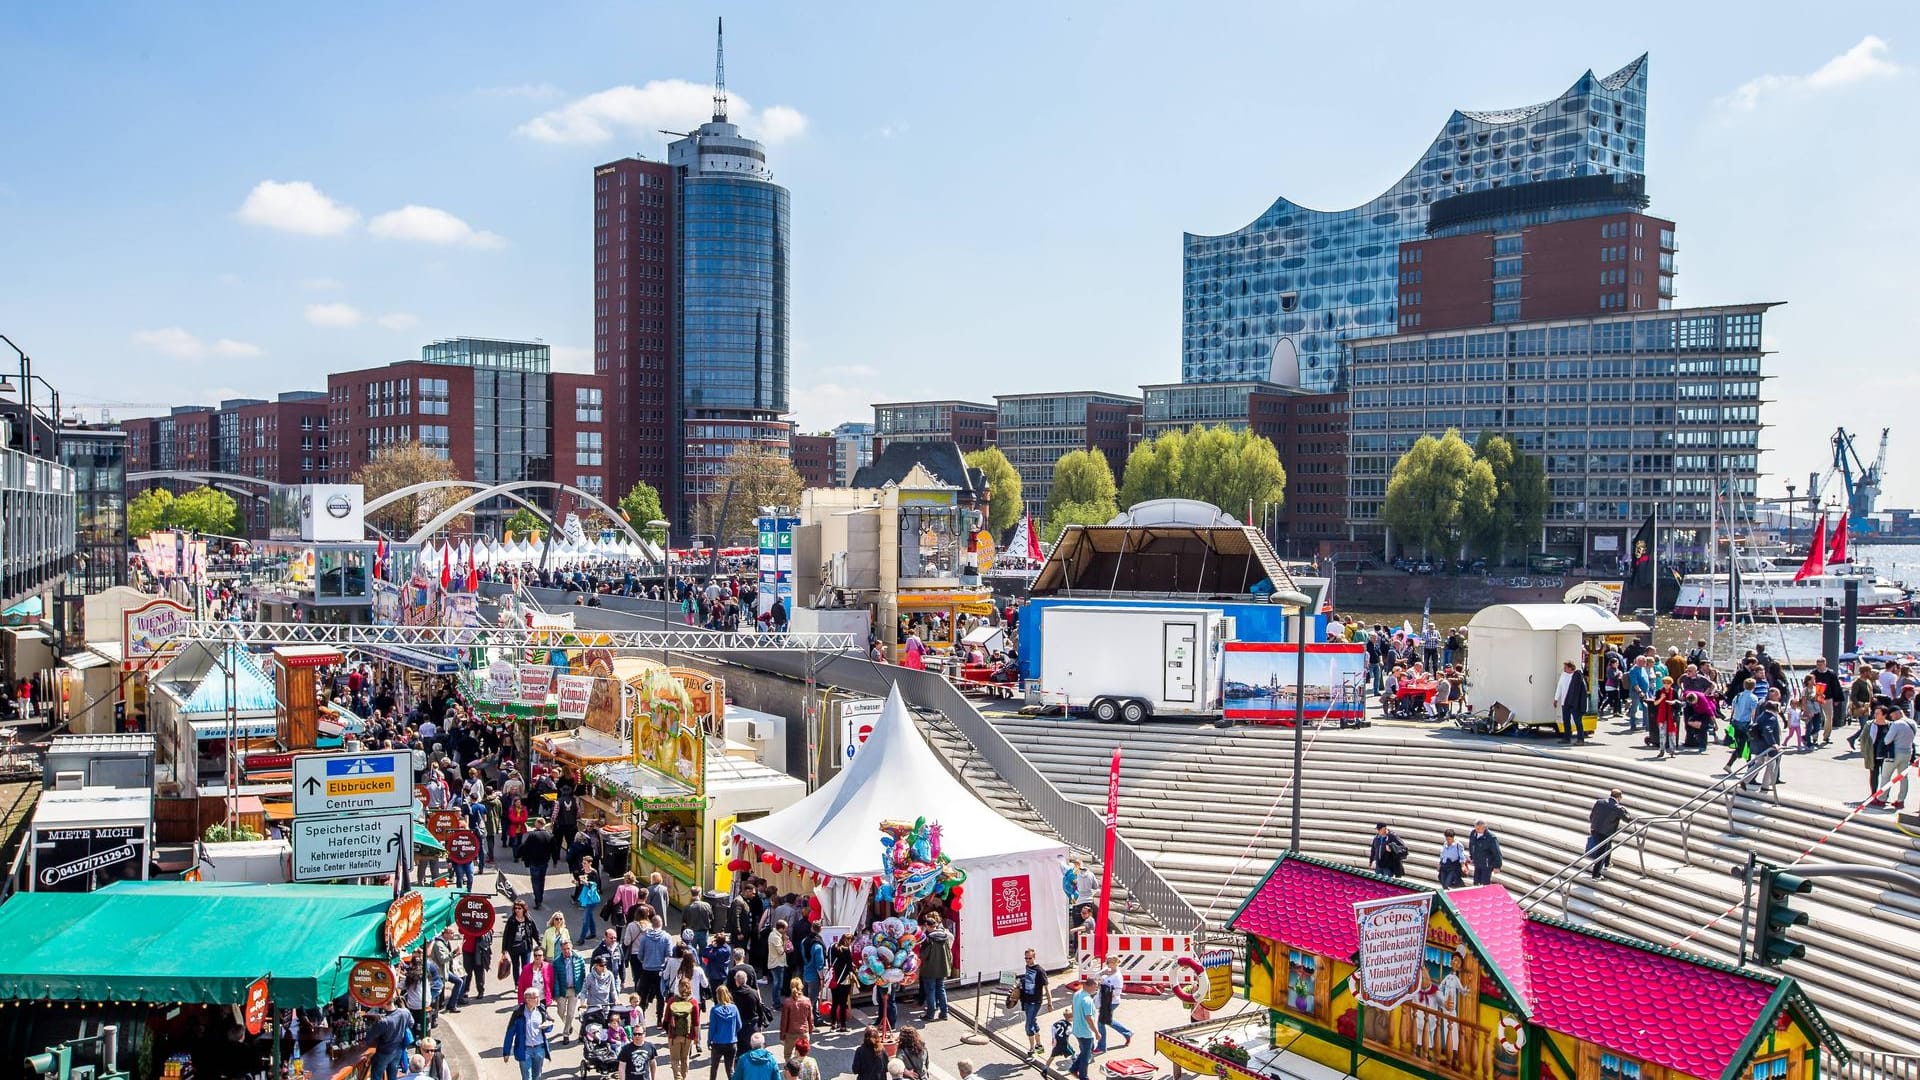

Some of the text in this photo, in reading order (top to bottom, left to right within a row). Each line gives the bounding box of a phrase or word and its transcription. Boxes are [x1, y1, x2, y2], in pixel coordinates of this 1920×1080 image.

[137, 611, 175, 631] WIENER
[329, 780, 392, 794] Elbbrücken
[326, 799, 374, 810] Centrum
[47, 827, 134, 841] MIETE MICH!
[305, 821, 382, 838] Speicherstadt
[328, 834, 382, 848] HafenCity
[60, 846, 131, 877] 04177/71129-0
[311, 847, 382, 863] Kehrwiederspitze
[299, 860, 382, 875] Cruise Center HafenCity
[467, 900, 484, 909] Bier
[471, 910, 489, 919] Fass
[1373, 911, 1414, 927] Crêpes
[1364, 924, 1422, 941] Kaiserschmarrn
[1365, 936, 1420, 954] Marillenknödel
[1365, 949, 1417, 967] Erdbeerknödel
